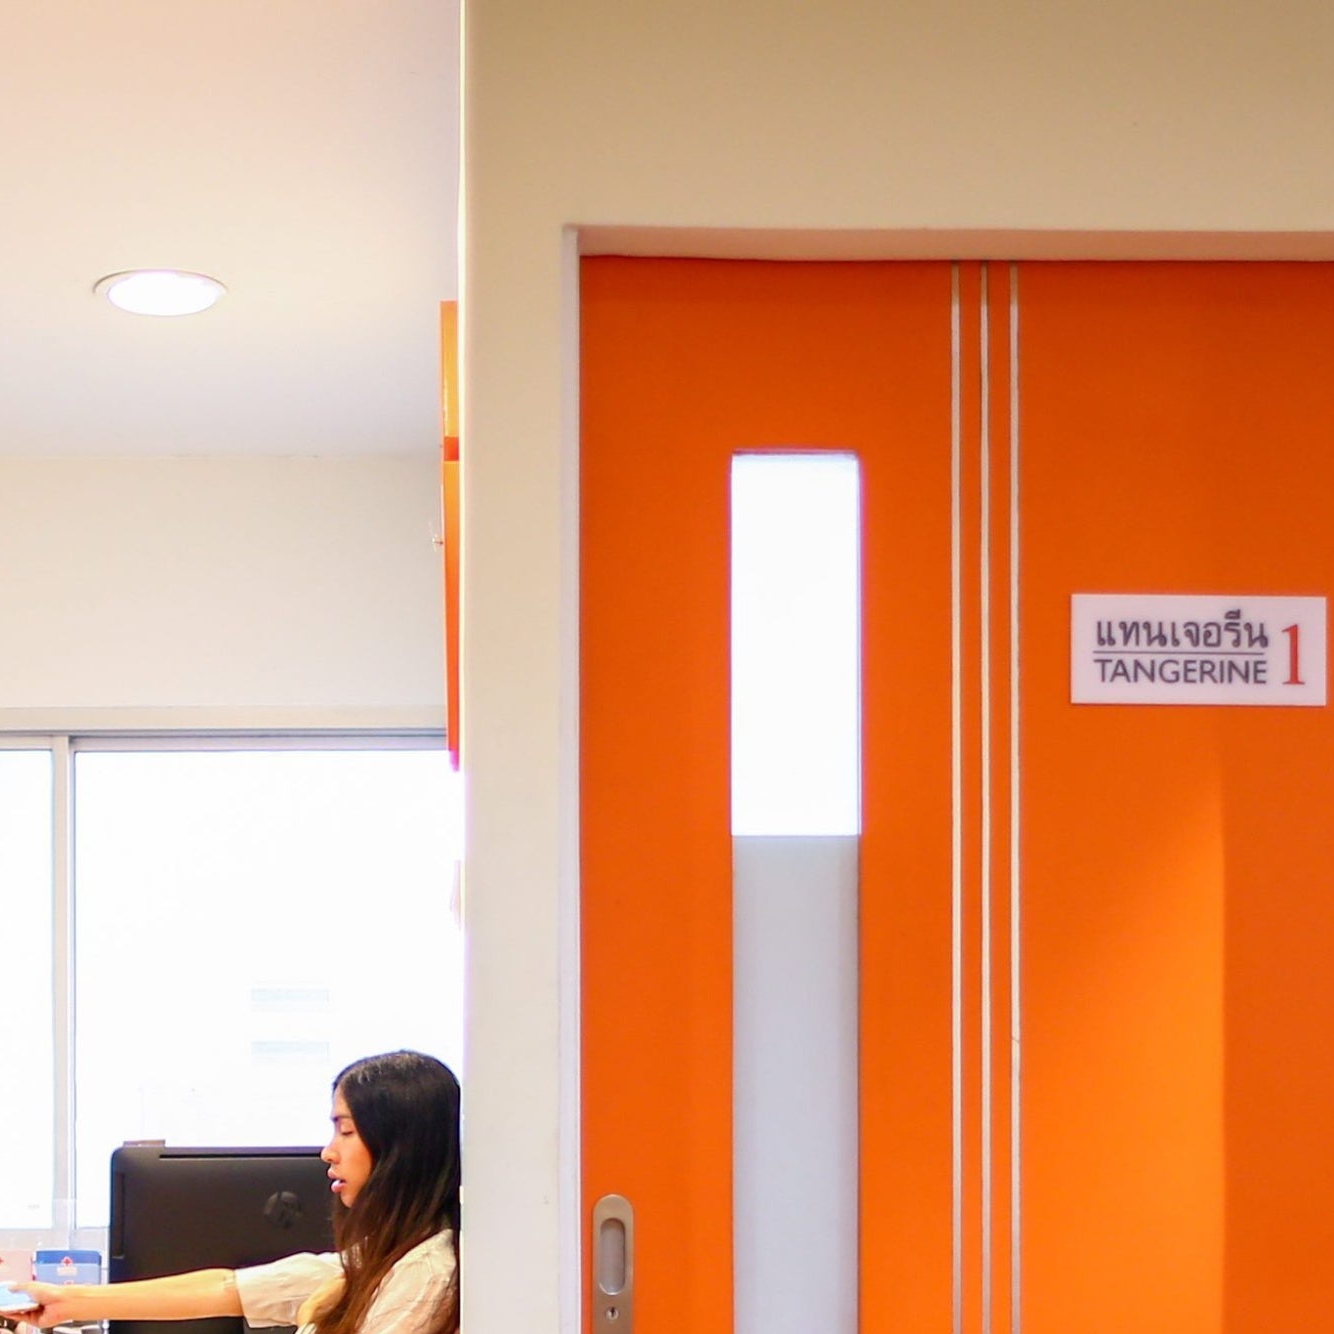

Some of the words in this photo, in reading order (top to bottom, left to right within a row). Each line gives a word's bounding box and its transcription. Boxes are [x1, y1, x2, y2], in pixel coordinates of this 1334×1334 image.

[1096, 608, 1269, 649] แทนเจอรีน
[1093, 658, 1268, 685] TANGERINE
[1281, 623, 1306, 686] 1
